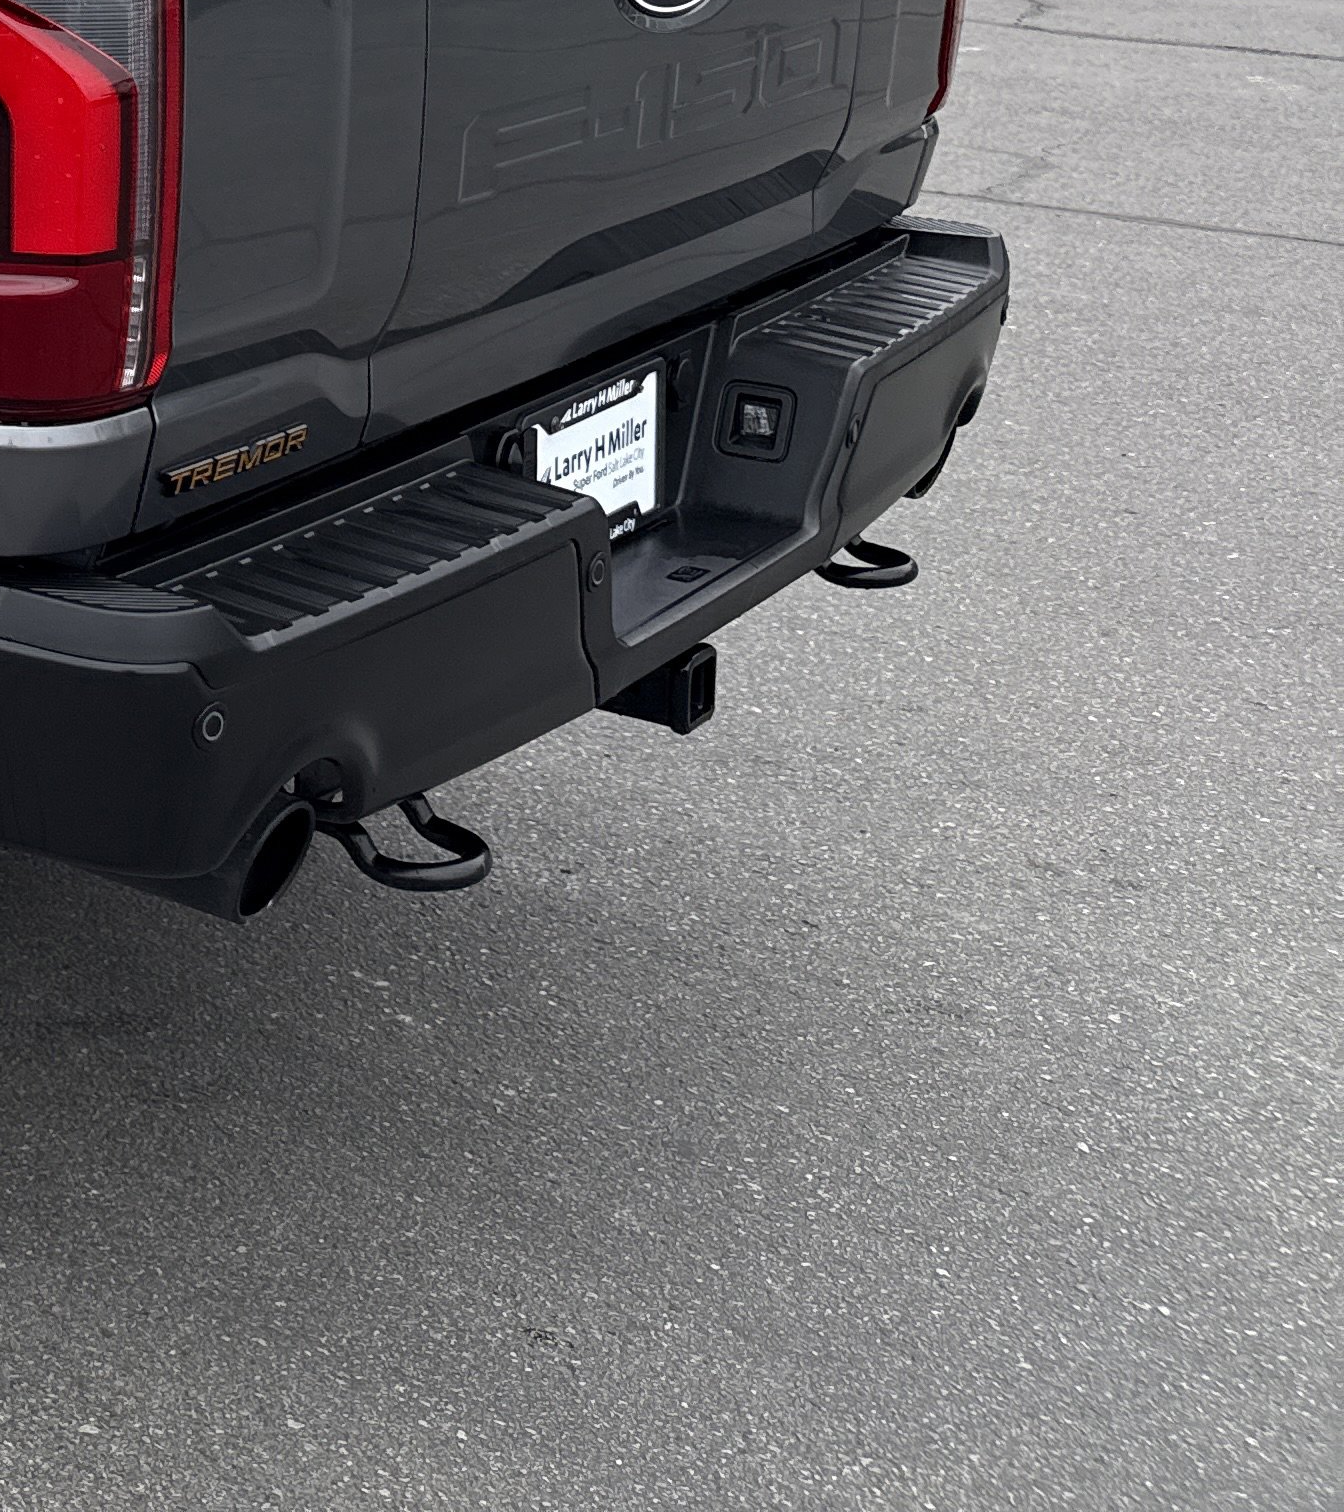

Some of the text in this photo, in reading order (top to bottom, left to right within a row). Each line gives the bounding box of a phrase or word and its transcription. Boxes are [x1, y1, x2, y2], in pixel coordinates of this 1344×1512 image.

[572, 377, 635, 418] Larry H Miller
[166, 423, 309, 496] TREMOR
[554, 417, 648, 482] Larry H Miller
[573, 474, 593, 492] Super
[593, 462, 608, 483] Ford
